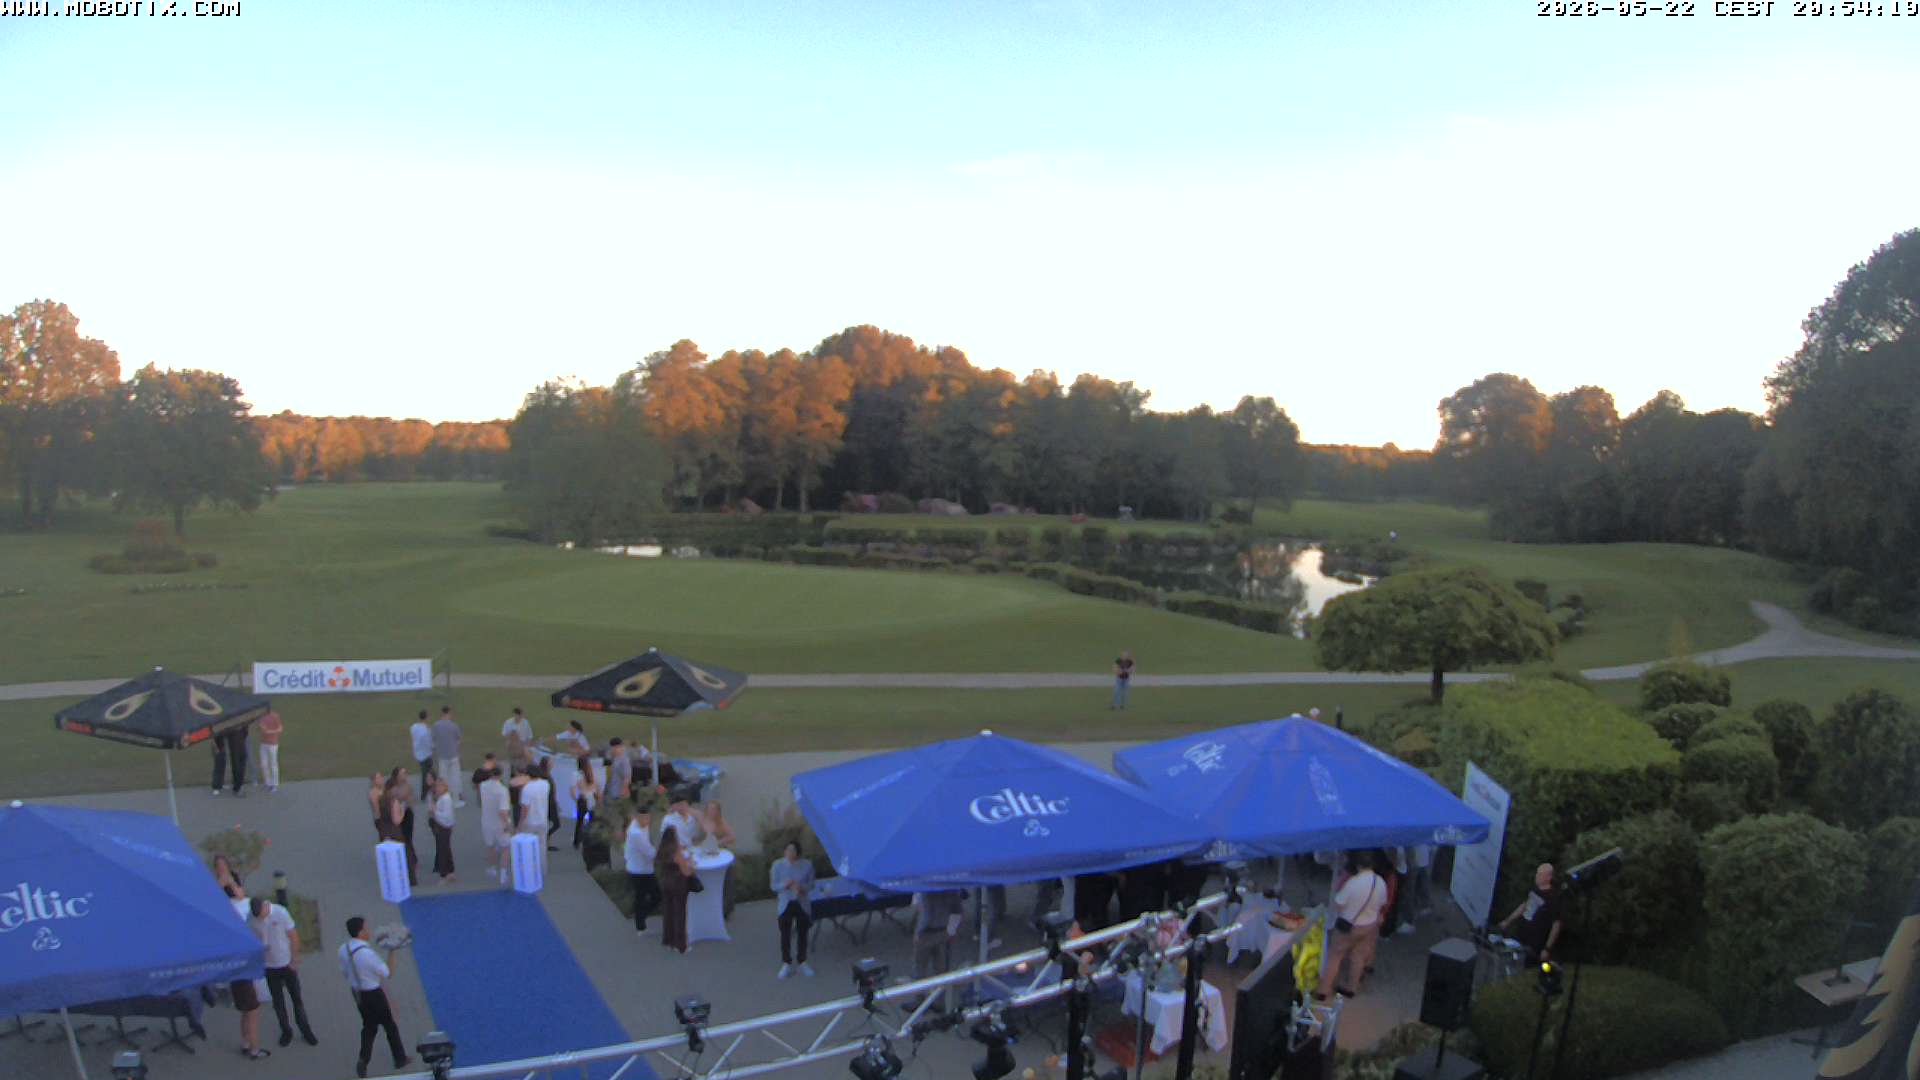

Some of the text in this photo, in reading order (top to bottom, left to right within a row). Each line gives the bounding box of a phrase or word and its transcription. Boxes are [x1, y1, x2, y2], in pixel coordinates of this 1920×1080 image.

[264, 667, 423, 689] Crédit Mutuel
[969, 788, 1068, 824] Celtic
